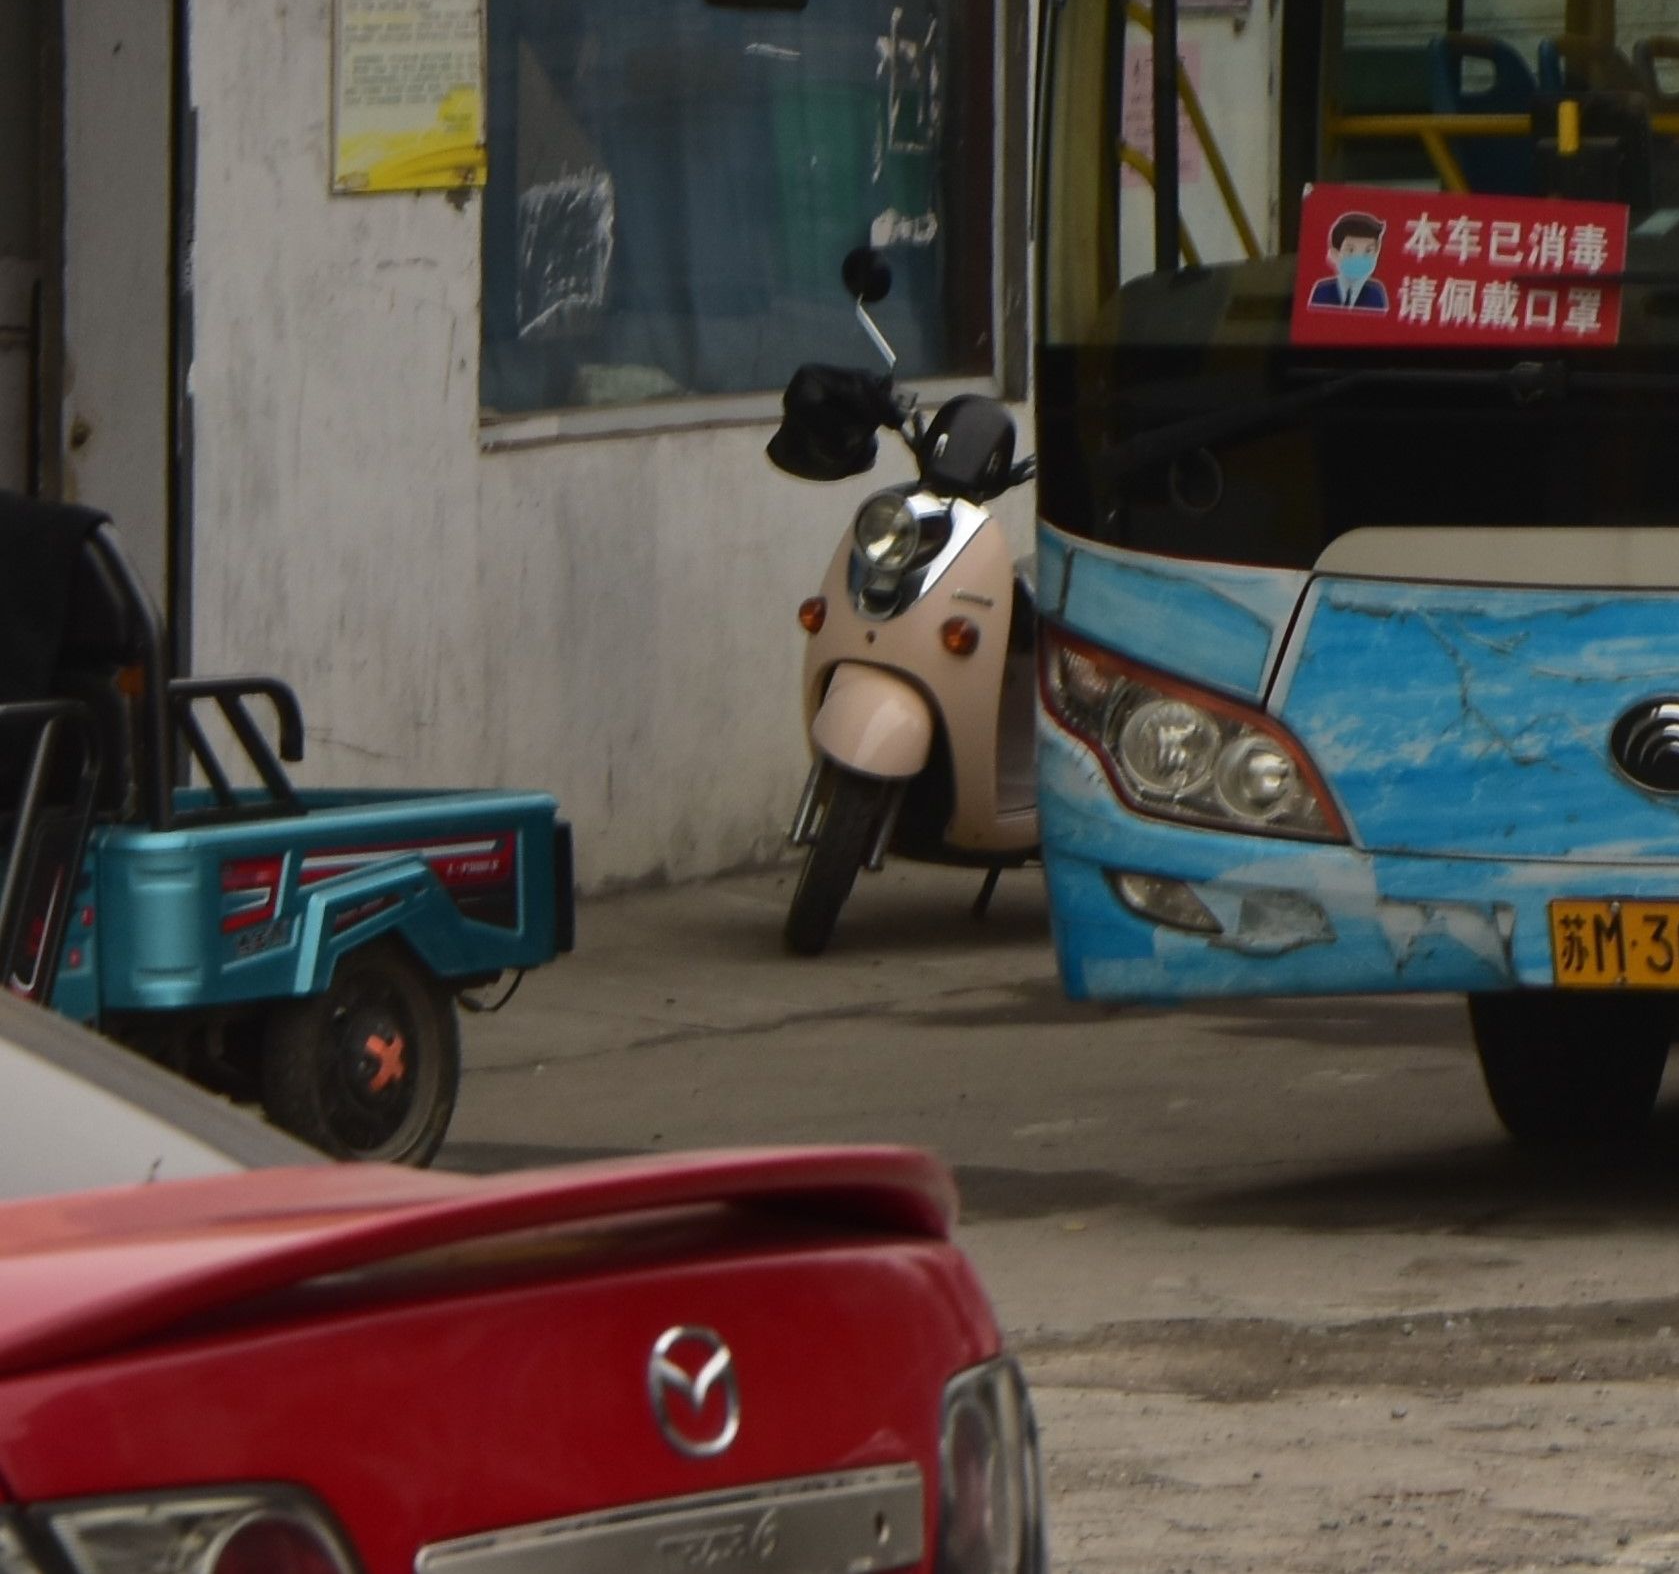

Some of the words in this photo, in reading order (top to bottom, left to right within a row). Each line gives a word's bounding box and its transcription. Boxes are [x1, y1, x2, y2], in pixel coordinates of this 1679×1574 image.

[1402, 211, 1608, 274] 本车已消毒
[1396, 276, 1602, 336] 请佩戴口罩
